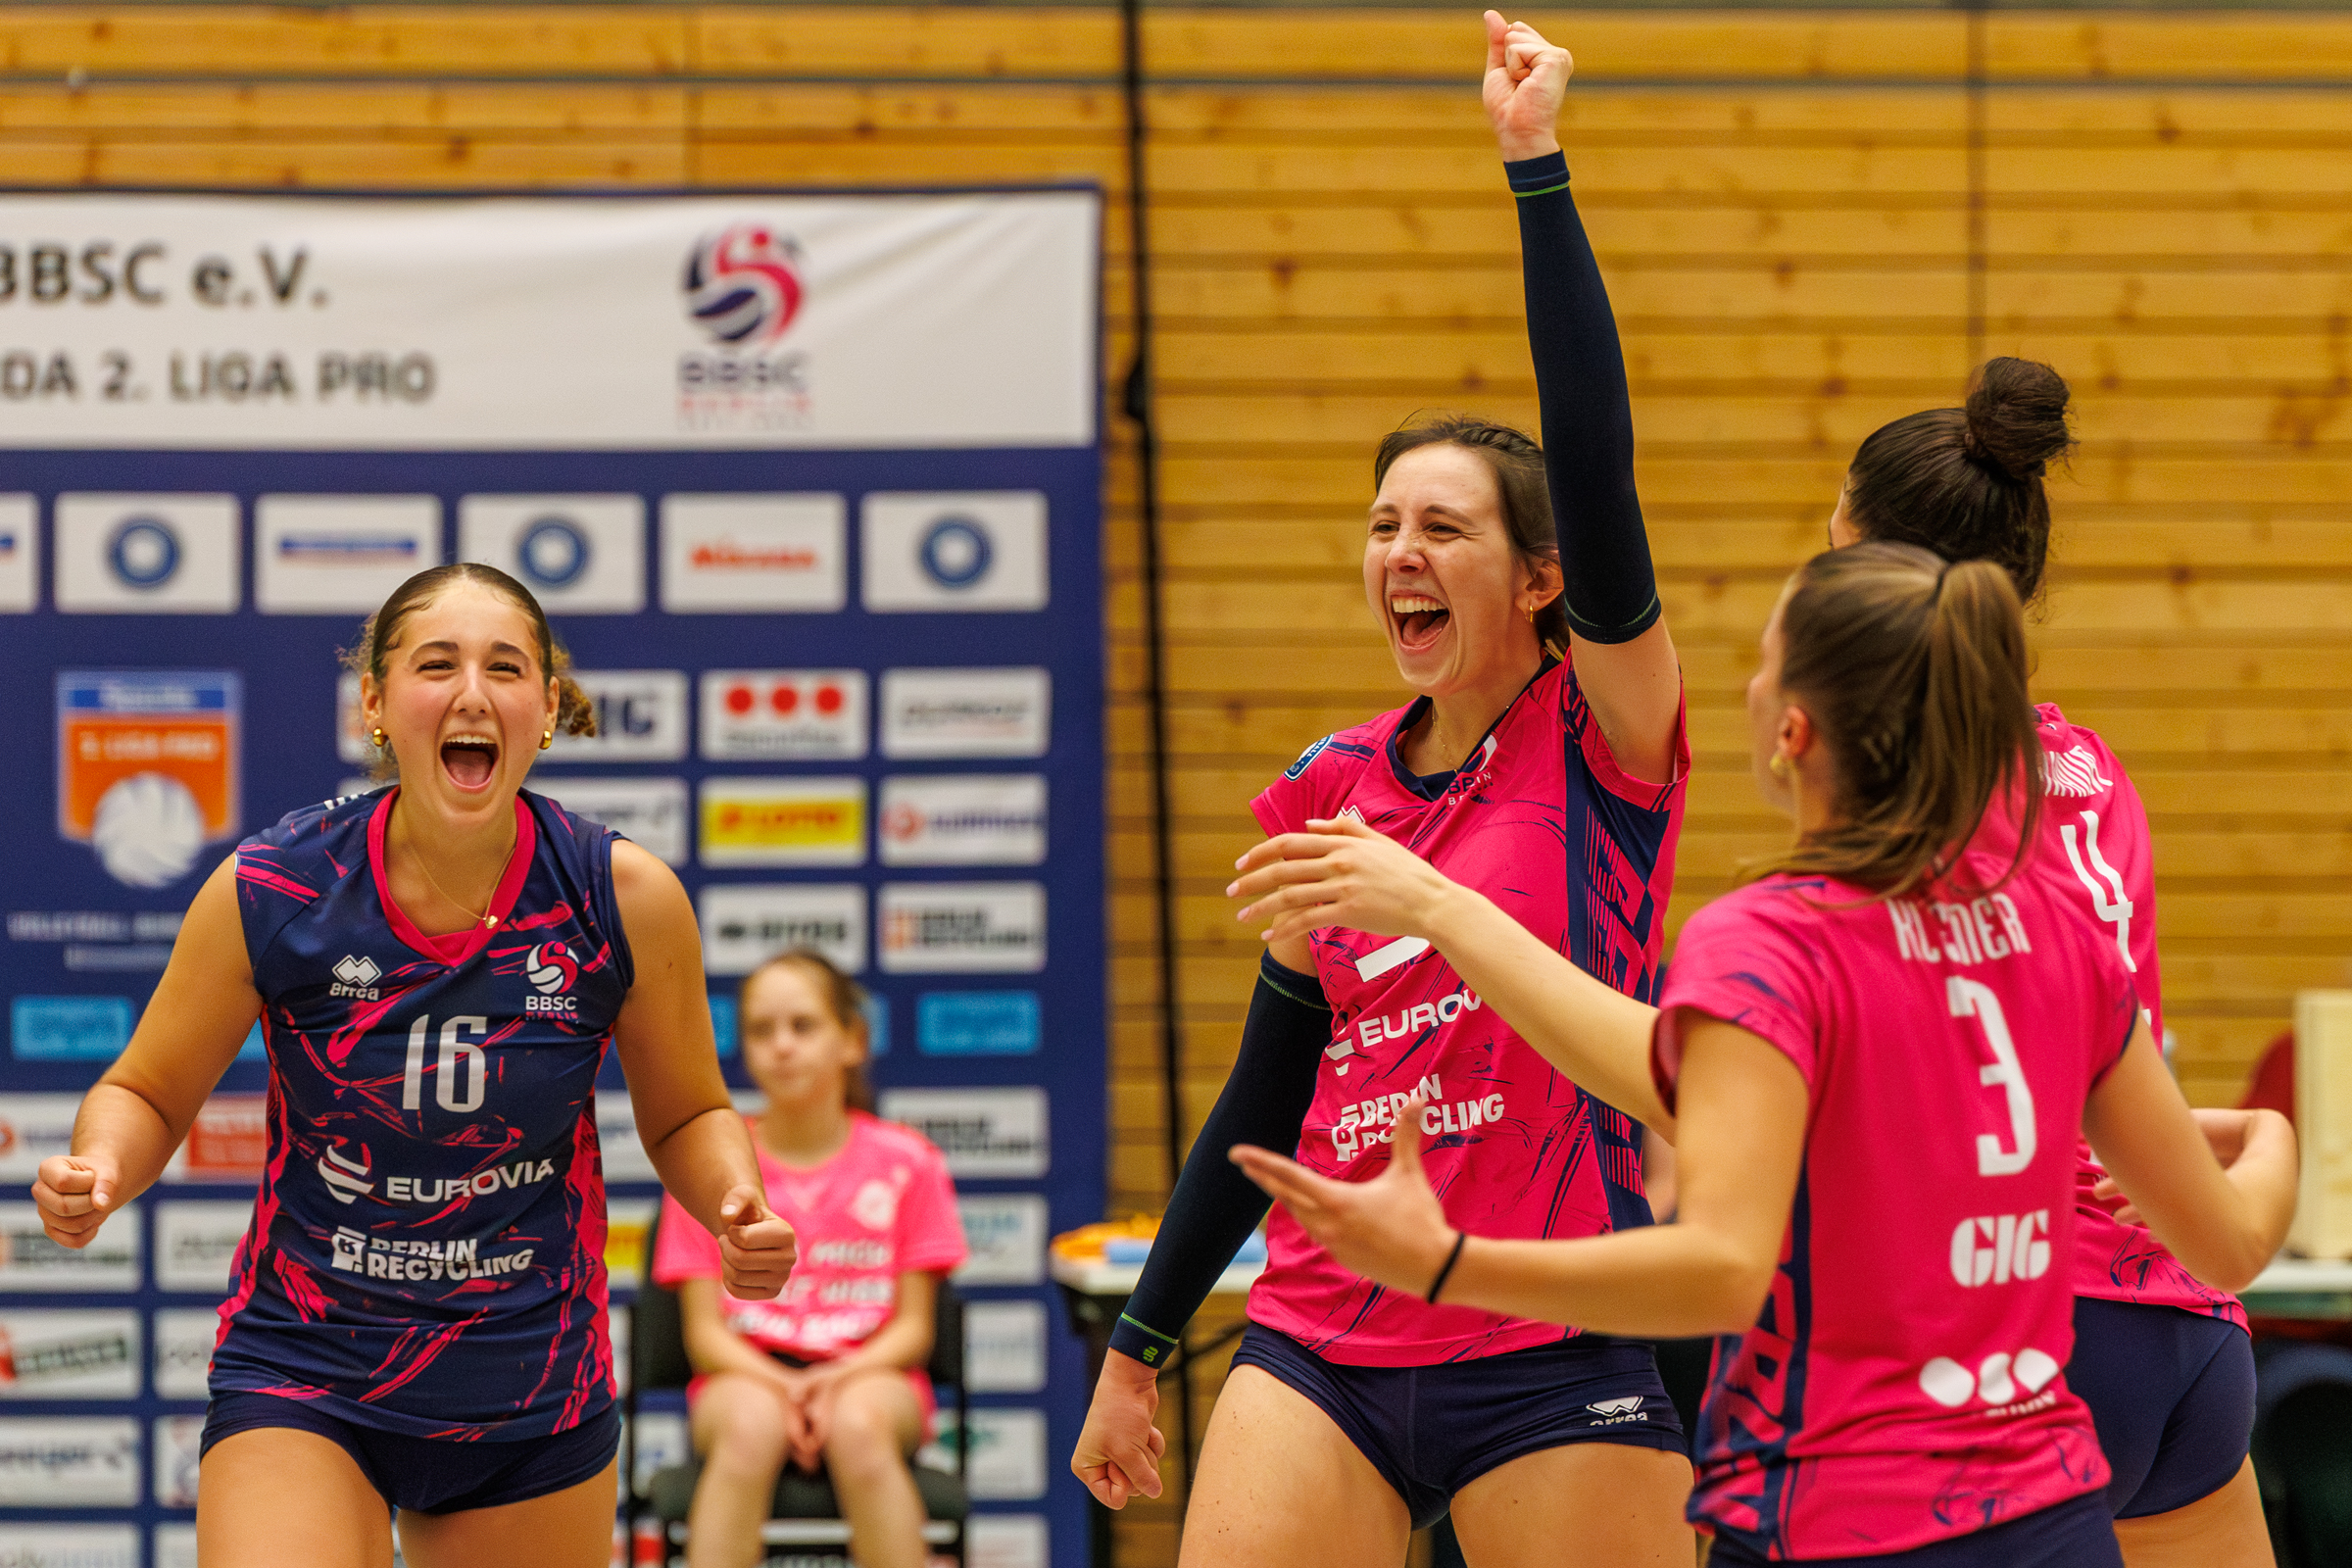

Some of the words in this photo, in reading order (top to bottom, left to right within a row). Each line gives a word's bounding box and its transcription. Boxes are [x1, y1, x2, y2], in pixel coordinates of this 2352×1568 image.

[192, 244, 329, 308] e.V.
[170, 350, 300, 404] LIGA
[318, 351, 438, 404] PRO
[2060, 809, 2137, 973] 4
[525, 996, 578, 1010] BBSC
[1358, 989, 1483, 1049] EUROV
[402, 1013, 488, 1113] 16
[1945, 975, 2037, 1176] 3
[386, 1158, 555, 1203] EUROVIA
[367, 1249, 535, 1282] RECYCLING
[1949, 1208, 2051, 1288] GIG
